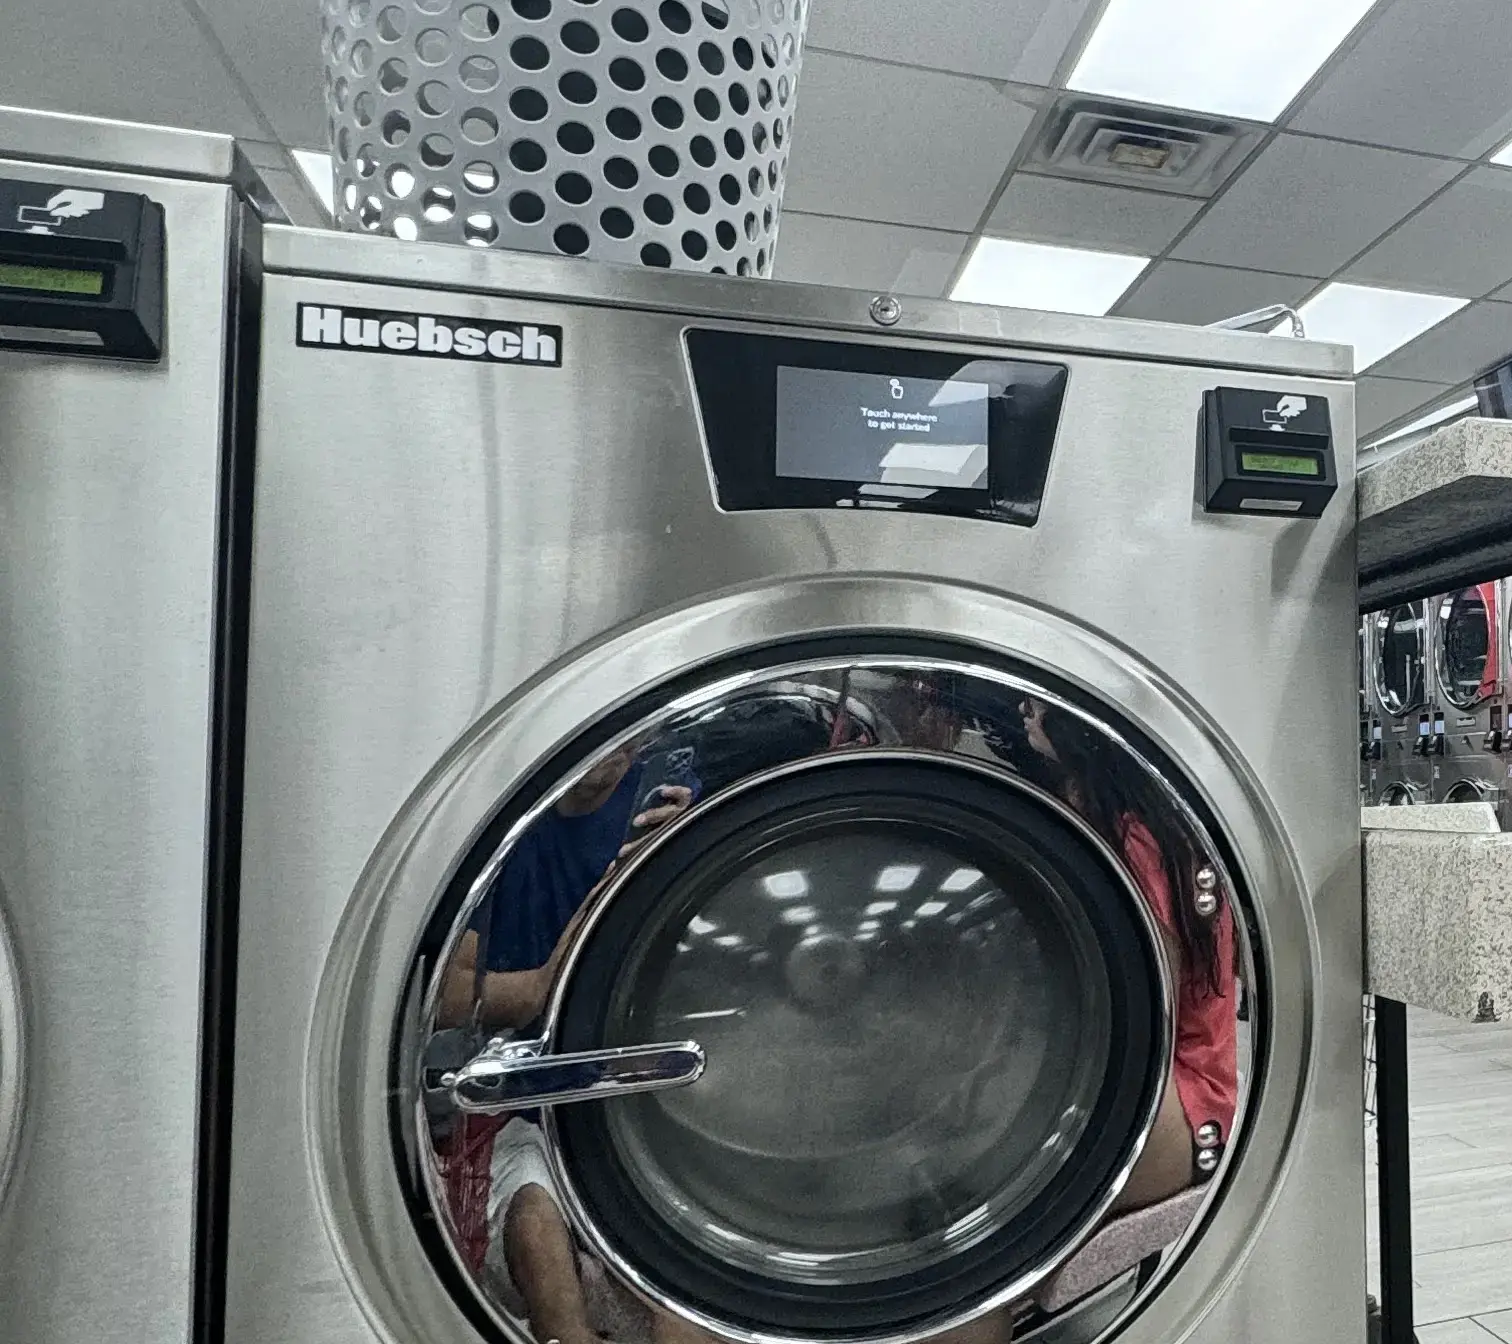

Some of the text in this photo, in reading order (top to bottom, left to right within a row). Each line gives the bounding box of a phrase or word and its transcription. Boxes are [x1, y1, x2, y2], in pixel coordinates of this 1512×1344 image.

[301, 305, 557, 363] Huebsch
[860, 407, 938, 423] Touch anywhere
[867, 419, 931, 432] to get started
